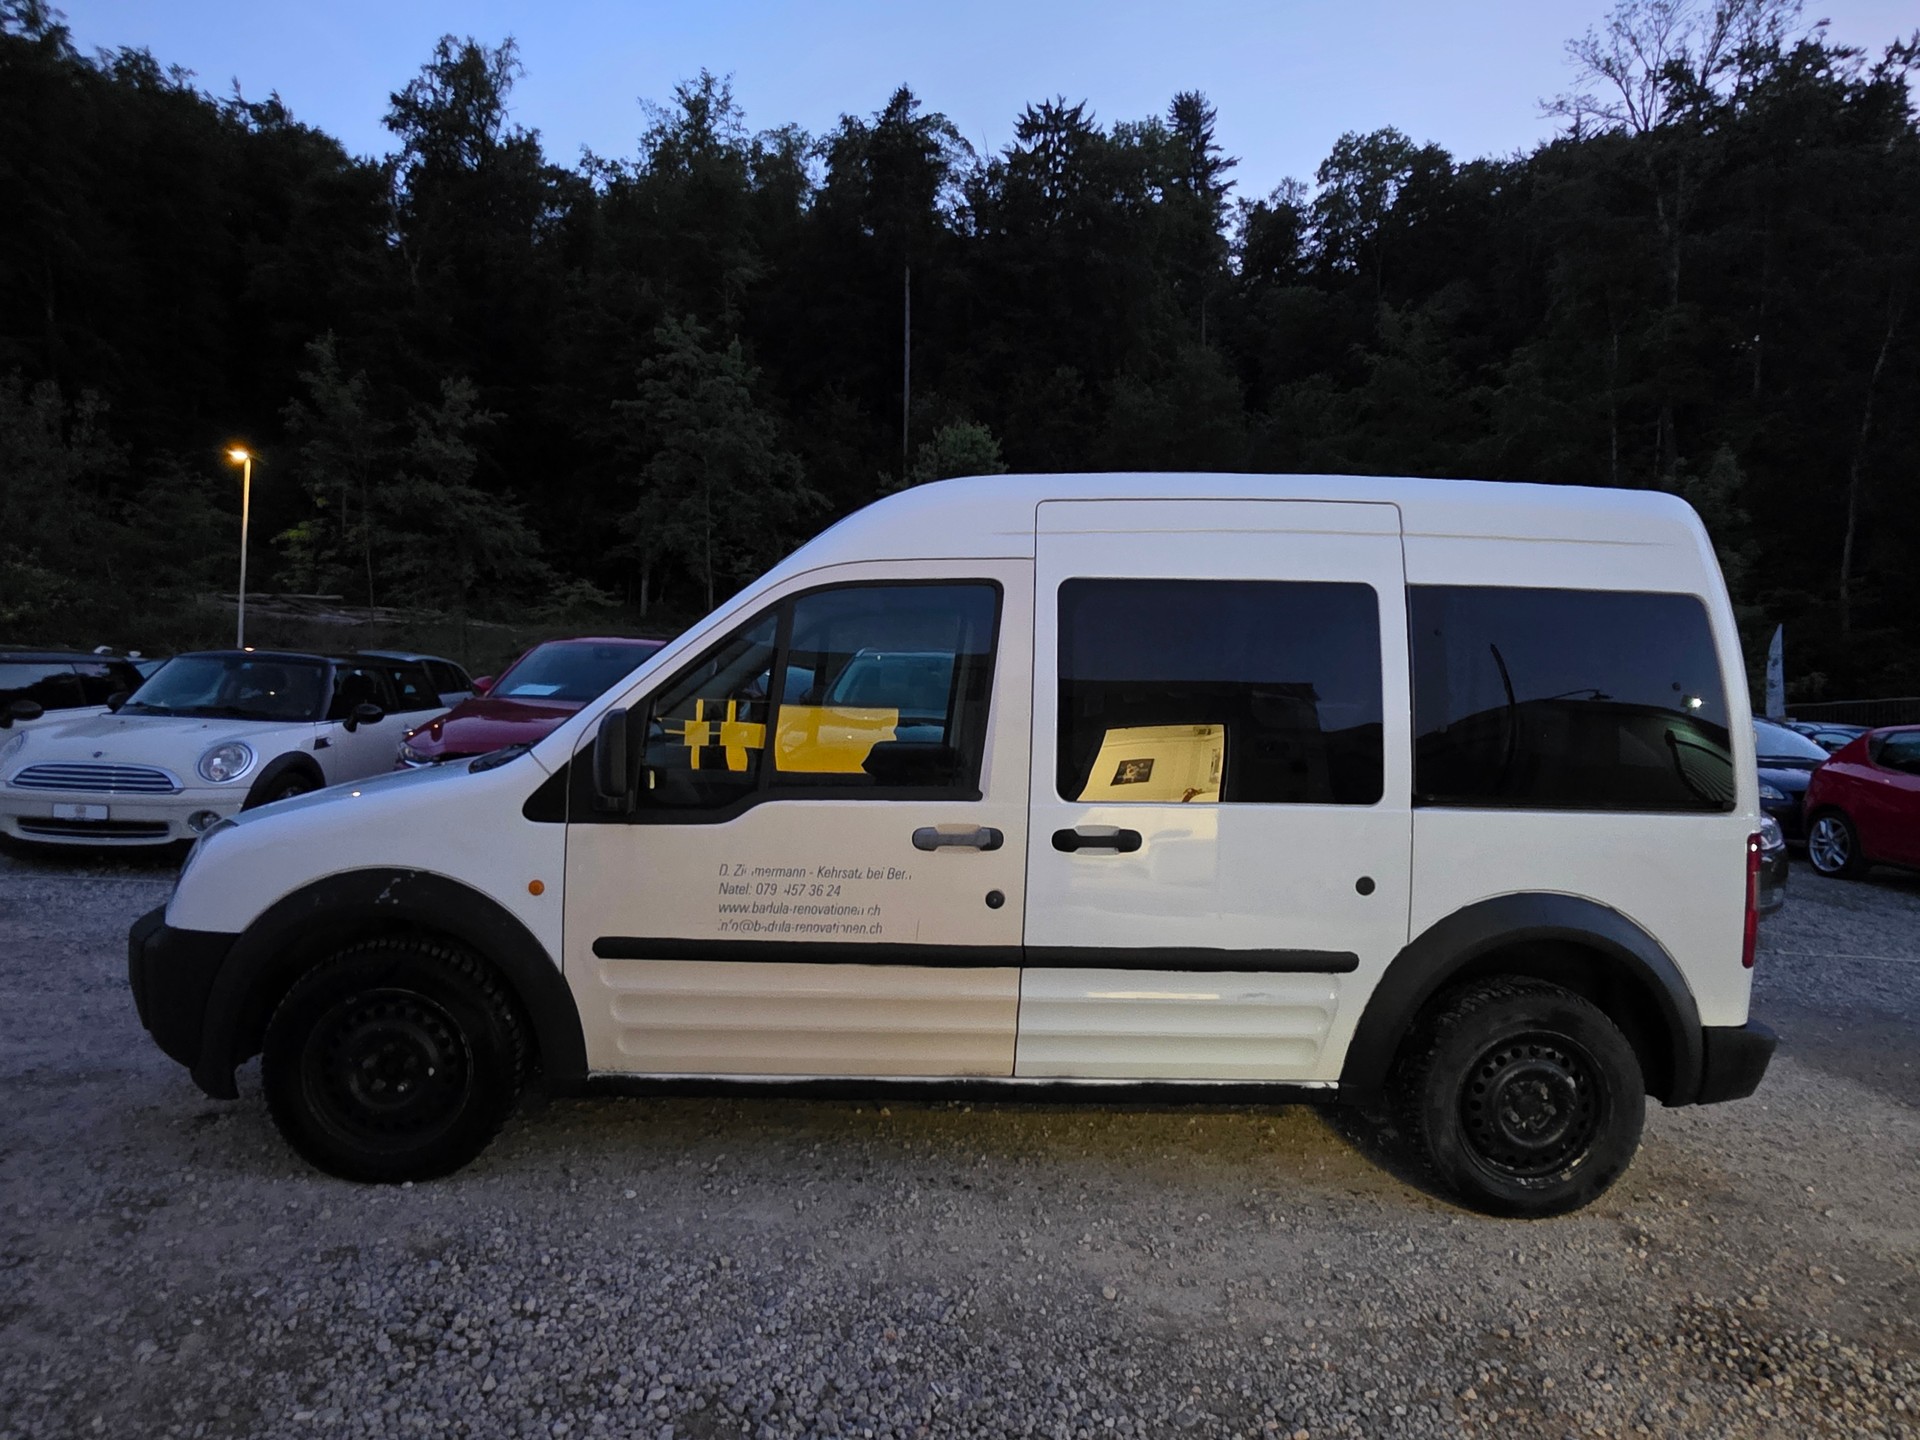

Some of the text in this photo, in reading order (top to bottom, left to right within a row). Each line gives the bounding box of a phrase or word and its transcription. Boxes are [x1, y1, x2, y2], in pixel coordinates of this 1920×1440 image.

[718, 863, 730, 877] D.
[866, 866, 885, 879] bei
[887, 867, 912, 881] Ber
[755, 882, 778, 896] 079
[808, 884, 824, 897] 36
[826, 885, 842, 897] 24
